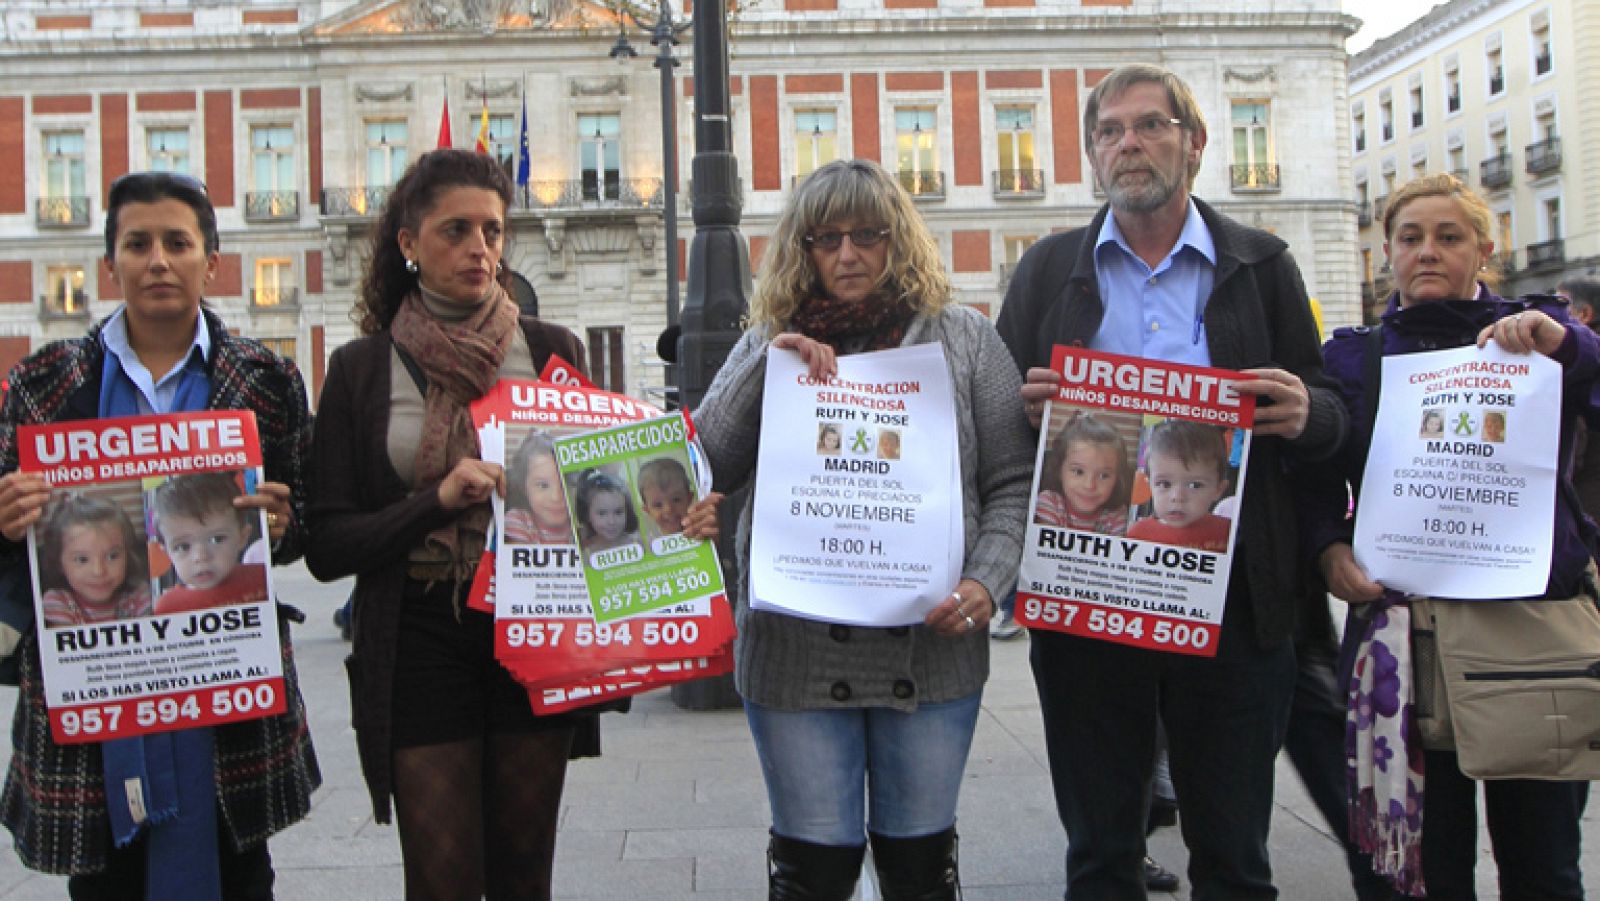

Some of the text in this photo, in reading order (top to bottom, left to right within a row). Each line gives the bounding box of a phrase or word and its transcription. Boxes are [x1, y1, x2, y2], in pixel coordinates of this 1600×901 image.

[1063, 356, 1241, 407] URGENTE
[1408, 361, 1529, 384] CONCENTRACION
[1425, 377, 1512, 394] SILENCIOSA
[816, 391, 906, 411] SILENCIOSA
[1059, 386, 1240, 424] NIÑOS DESAPARECIDOS
[1421, 392, 1516, 407] RUTH Y JOSE
[815, 406, 909, 426] RUTH Y JOSE
[35, 418, 244, 464] URGENTE
[557, 421, 684, 466] DESAPARECIDOS
[1426, 441, 1495, 457] MADRID
[99, 452, 247, 479] DESAPARECIDOS
[824, 458, 891, 475] MADRID
[1412, 456, 1508, 474] PUERTA DEL SOL
[810, 475, 905, 490] PUERTA DEL SOL
[1393, 469, 1444, 481] ESQUINA
[1460, 474, 1526, 488] PRECIADOS
[791, 485, 840, 498] ESQUINA
[858, 490, 922, 504] PRECIADOS
[1393, 484, 1519, 507] 8 NOVIEMBRE
[791, 501, 916, 524] 8 NOVIEMBRE
[1423, 518, 1488, 536] 18:00 H.
[820, 537, 887, 556] 18:00 H.
[1038, 528, 1217, 574] RUTH Y JOSE
[1427, 537, 1447, 547] QUE
[1448, 539, 1492, 551] VUELVAN
[1493, 544, 1501, 552] A
[597, 545, 639, 567] RUTH
[824, 557, 845, 567] QUE
[847, 560, 891, 571] VUELVAN
[893, 562, 900, 571] A
[600, 589, 632, 612] 957
[639, 580, 673, 603] 594
[677, 571, 710, 593] 500
[1031, 582, 1043, 592] SI
[1046, 583, 1071, 596] LOS
[1074, 588, 1099, 601] HAS
[1103, 593, 1140, 608] VISTO
[1143, 600, 1186, 616] LLAMA
[1189, 608, 1211, 619] AL:
[511, 604, 524, 614] SI
[528, 604, 553, 614] LOS
[557, 604, 583, 614] HAS
[56, 607, 261, 653] RUTH Y JOSE
[507, 621, 699, 647] 957 594 500
[1024, 598, 1210, 648] 957 594 500
[62, 691, 76, 702] SI
[79, 687, 109, 700] LOS
[113, 683, 142, 696] HAS
[146, 676, 189, 692] VISTO
[193, 669, 242, 685] LLAMA
[60, 683, 275, 736] 957 594 500
